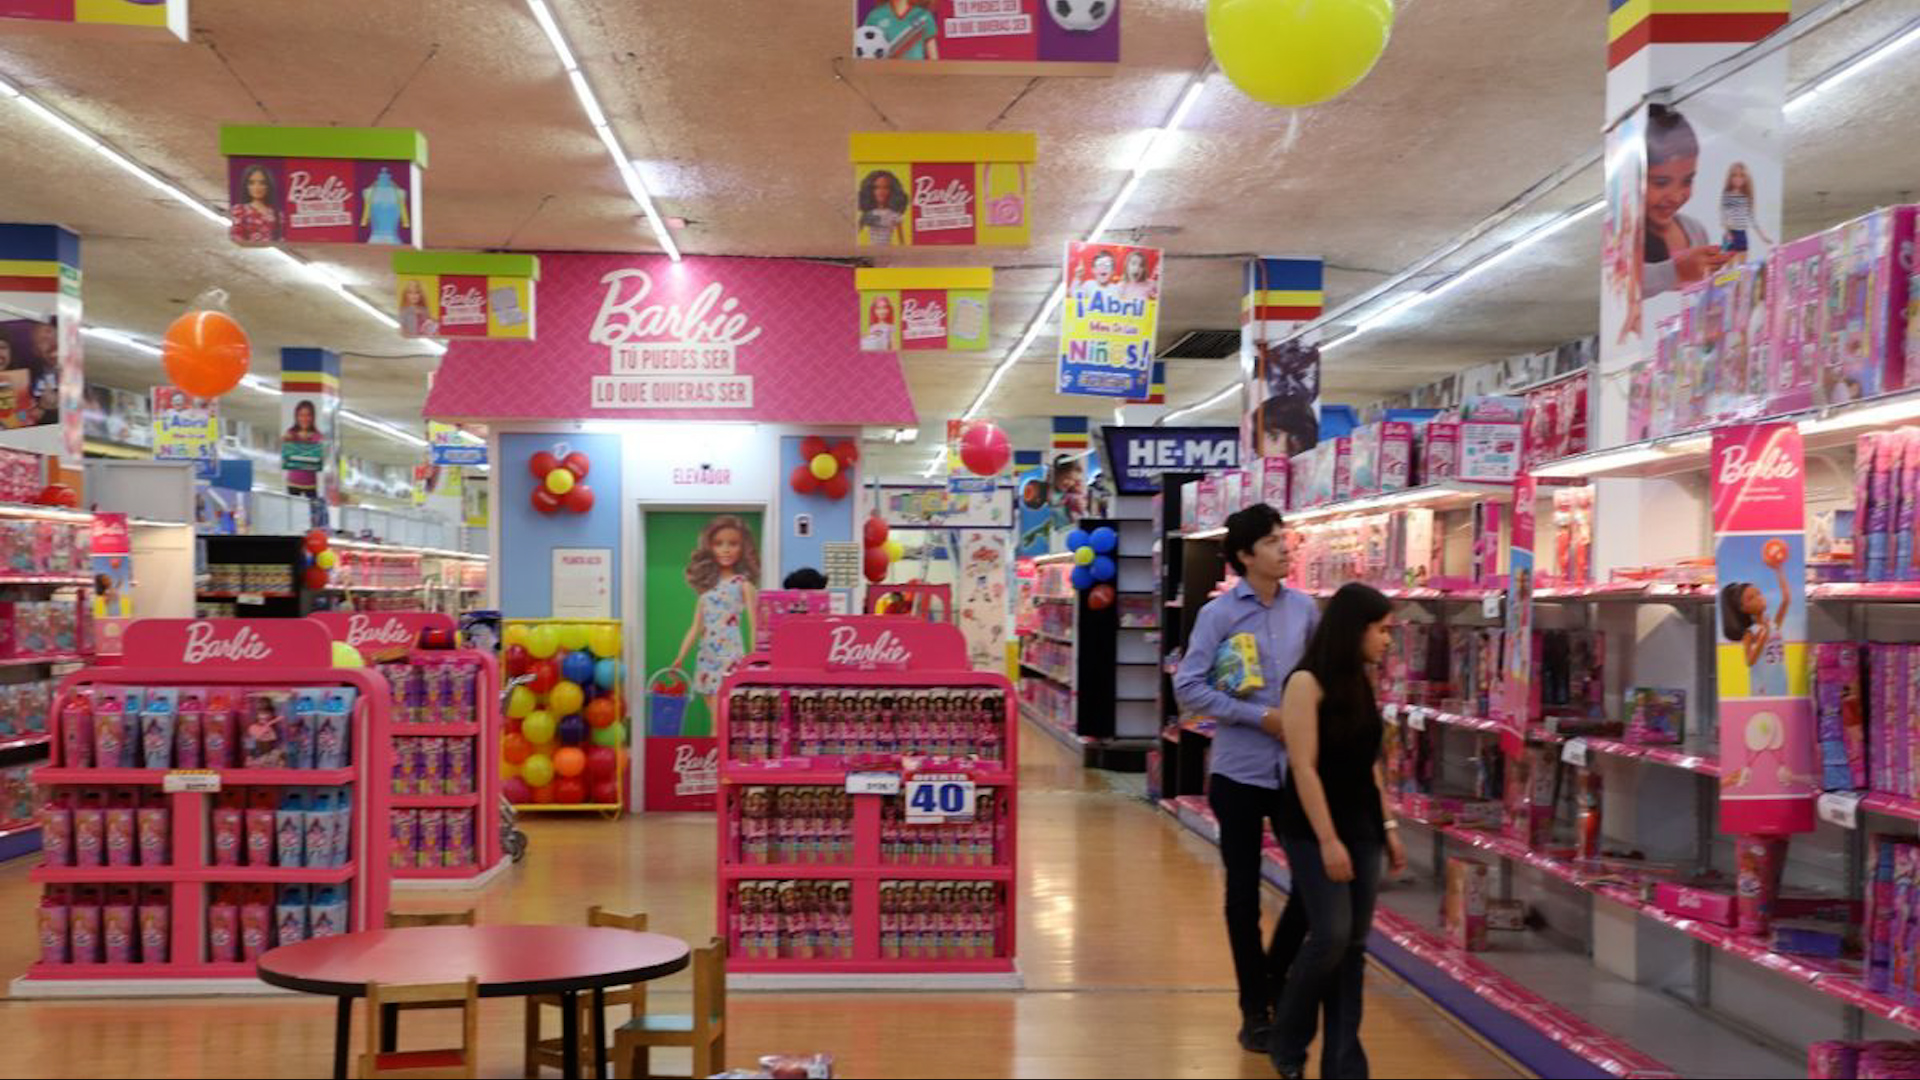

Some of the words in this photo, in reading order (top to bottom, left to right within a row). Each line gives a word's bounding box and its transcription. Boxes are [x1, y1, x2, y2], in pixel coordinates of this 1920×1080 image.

[289, 170, 354, 204] Barbie
[913, 175, 974, 207] Barbie
[441, 284, 487, 307] Barbie
[588, 268, 763, 347] Barbie
[902, 297, 948, 321] Barbie
[641, 350, 698, 370] PUEDES
[701, 350, 731, 370] SER
[596, 382, 616, 402] LO
[619, 382, 648, 402] QUE
[652, 382, 716, 402] QUIERAS
[718, 382, 746, 402] SER
[673, 467, 731, 486] ELEVADOR
[1718, 444, 1800, 485] Barbie
[182, 621, 272, 664] Barbie
[346, 614, 412, 647] Barbie
[828, 625, 912, 665] Barbie
[672, 744, 718, 773] Barb
[911, 783, 965, 813] 40
